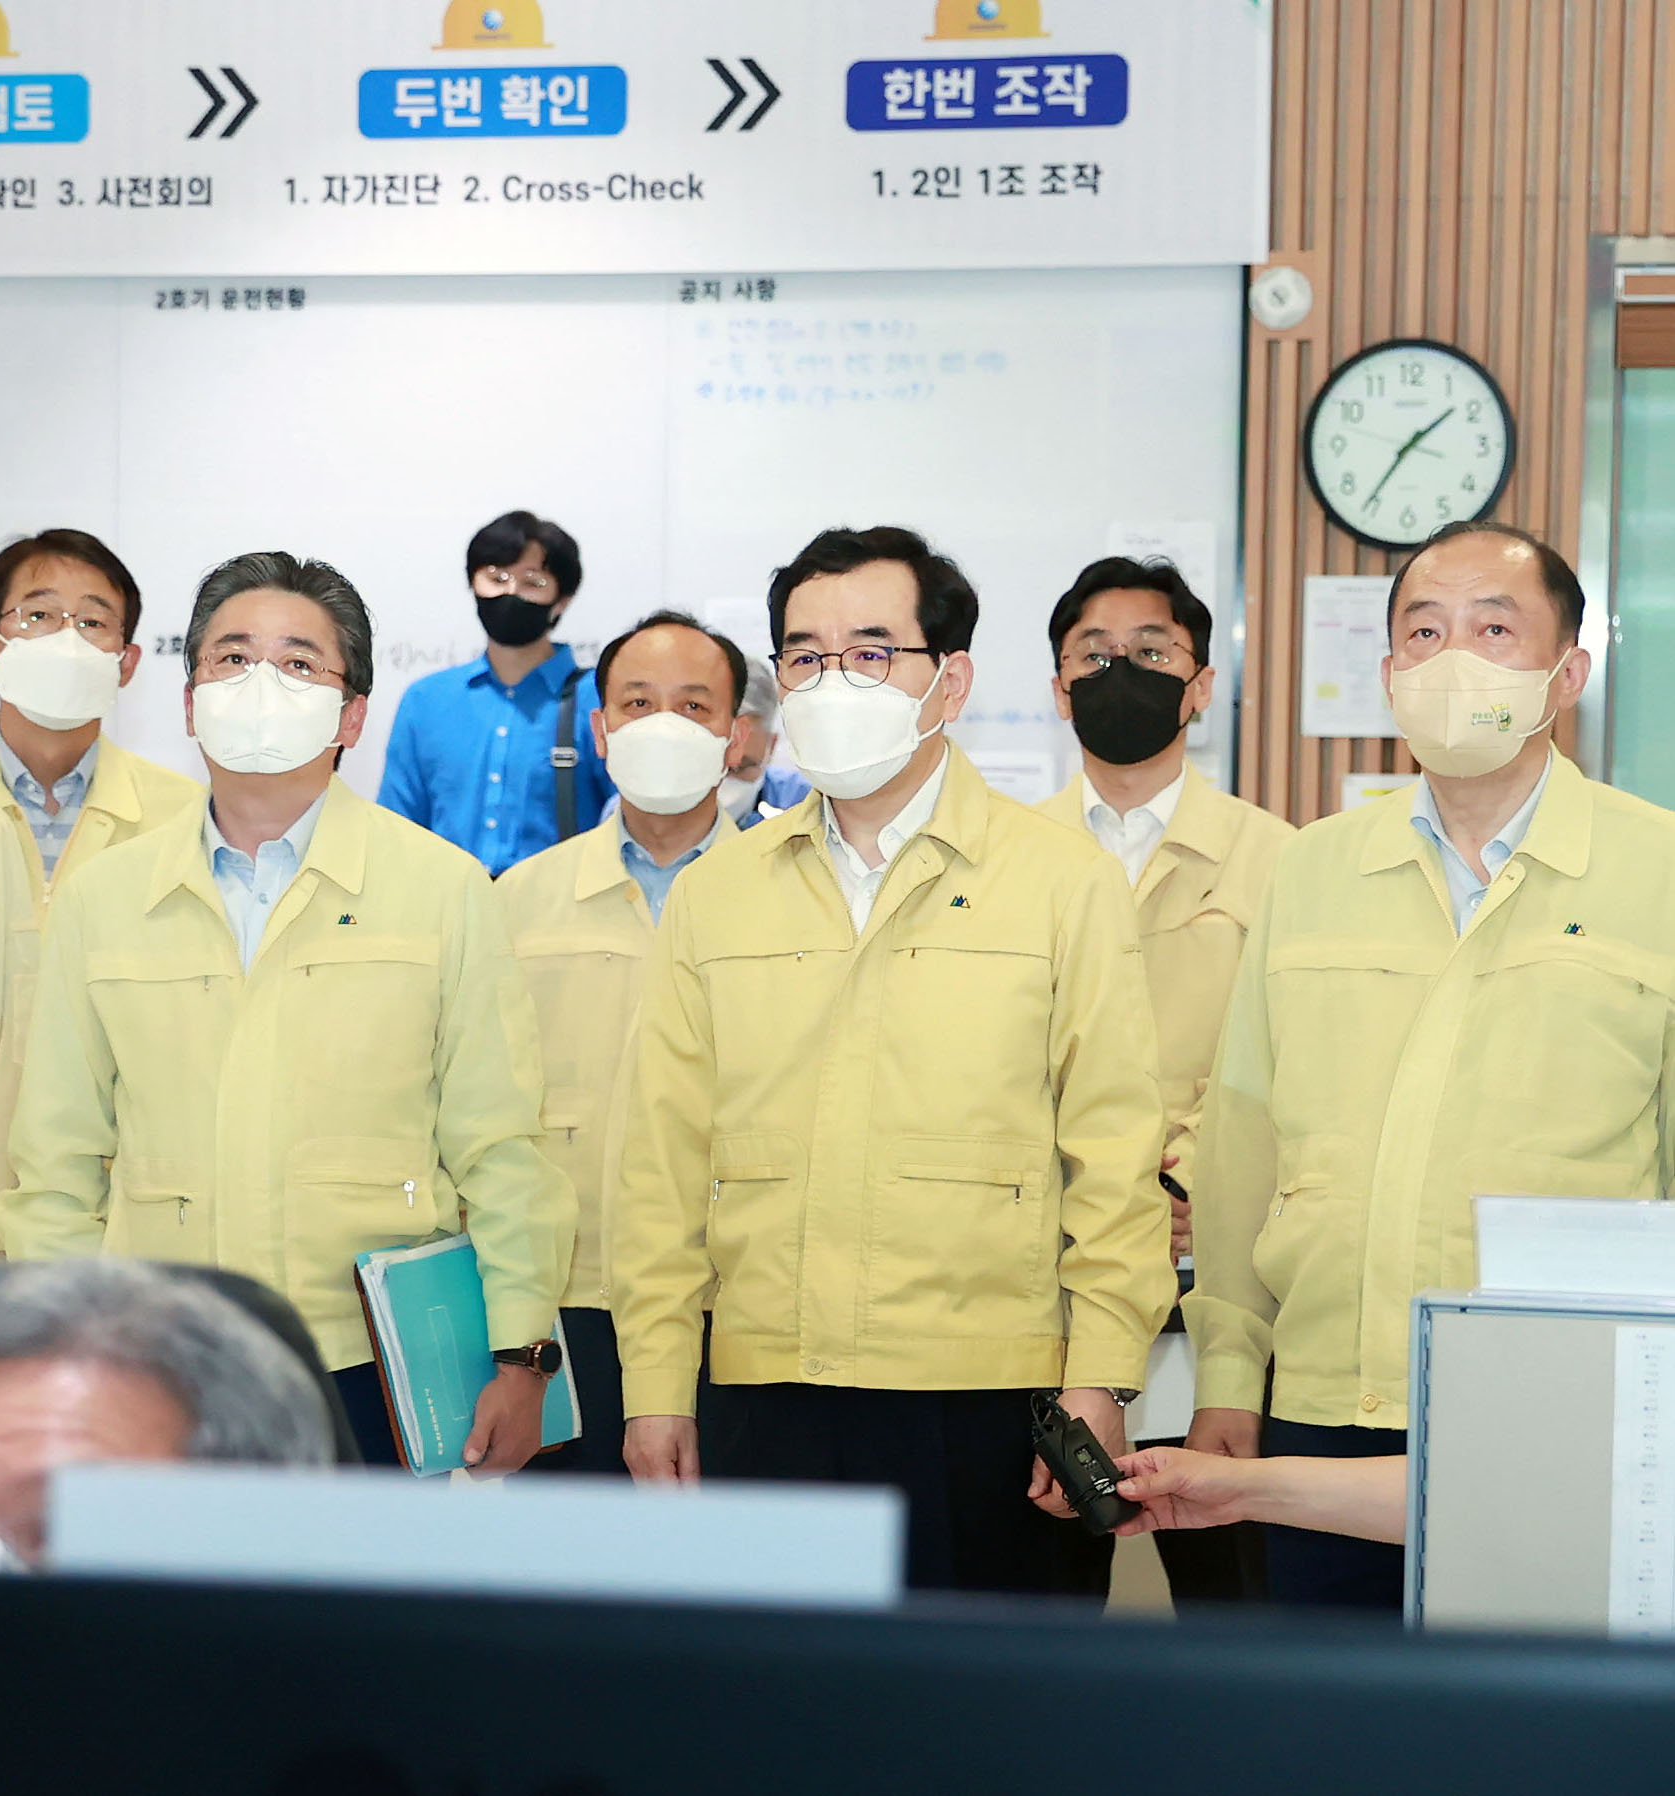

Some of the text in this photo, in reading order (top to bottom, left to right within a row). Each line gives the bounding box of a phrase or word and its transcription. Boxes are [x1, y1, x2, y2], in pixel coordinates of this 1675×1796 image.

[393, 75, 592, 129] 두번 확인
[882, 63, 1093, 119] 한번 조작
[58, 179, 84, 207] 3.
[97, 176, 212, 208] 사전회의
[285, 173, 704, 205] 1. 자가진단 2. Cross-Check
[873, 163, 1102, 199] 1. 2인 1조 조작
[155, 287, 210, 310] 2호기
[677, 276, 781, 306] 공지 사항
[1366, 374, 1385, 397] 11
[1399, 362, 1425, 387] 12
[1444, 374, 1453, 397] 1
[1340, 400, 1364, 425] 10
[1466, 400, 1482, 424] 2
[1329, 434, 1347, 459] 9
[1476, 434, 1490, 458] 3
[1339, 472, 1355, 496] 8
[1461, 474, 1477, 493] 4
[1399, 505, 1417, 530] 6
[1436, 496, 1452, 519] 5
